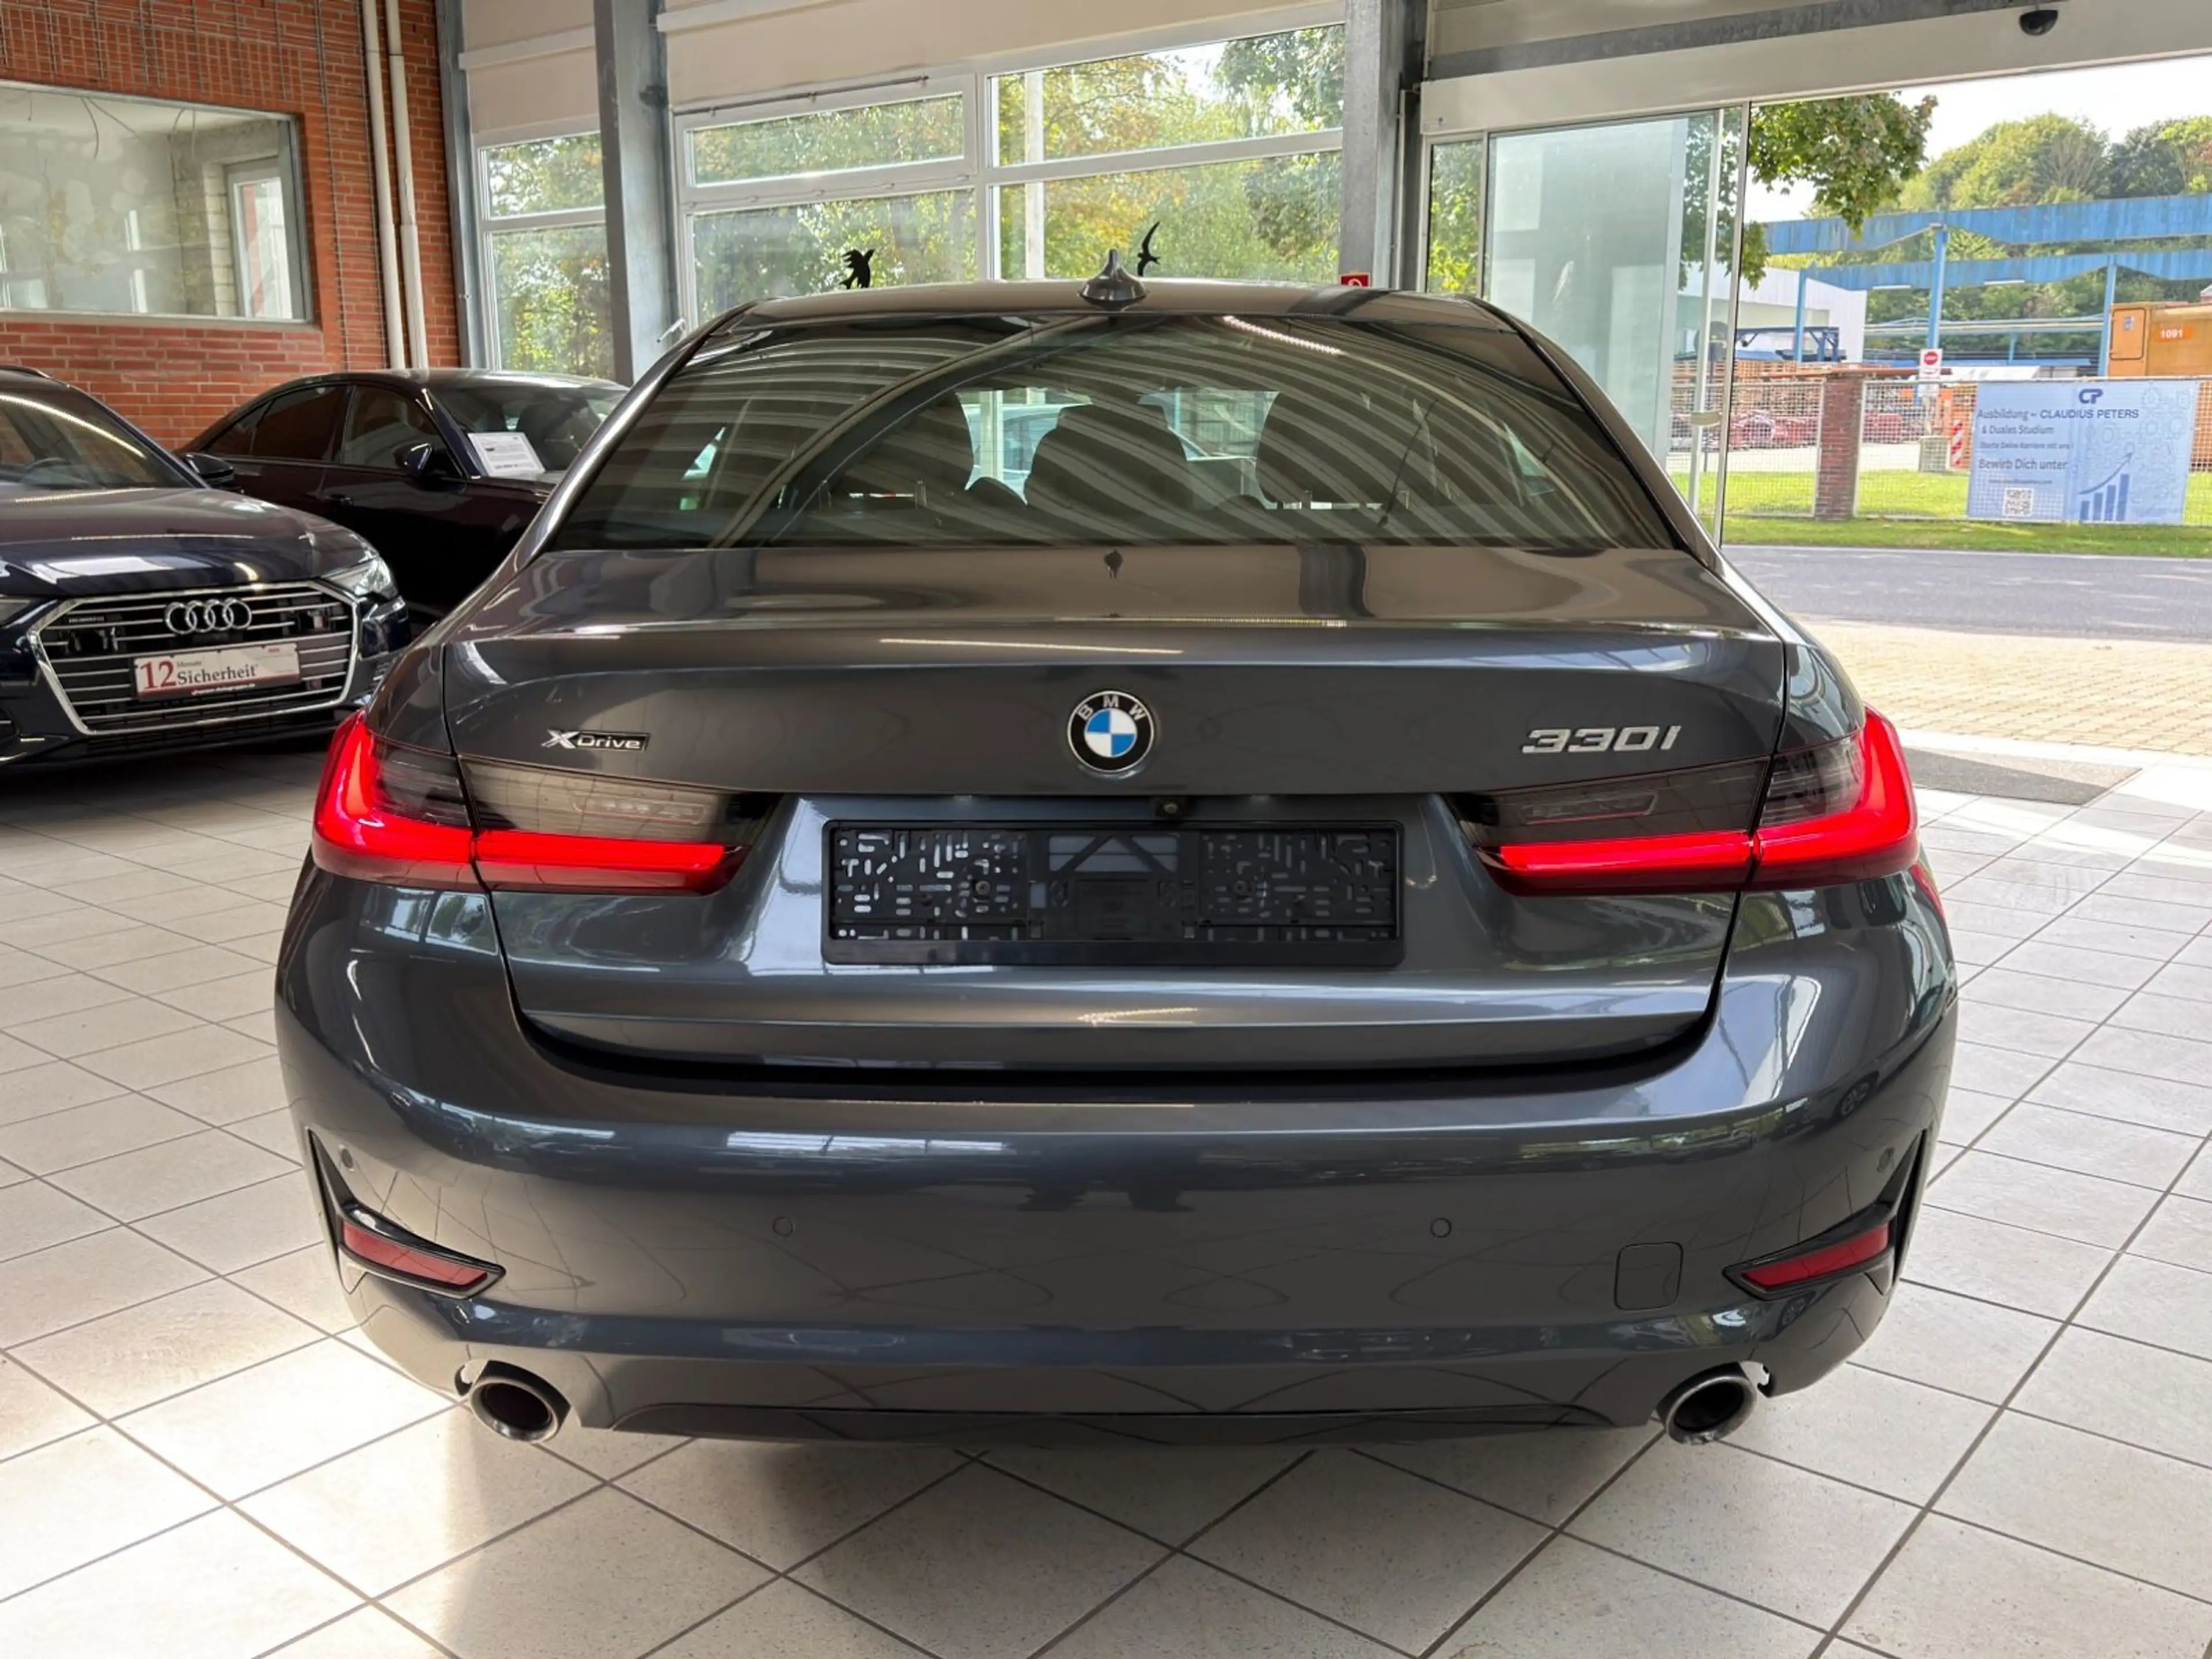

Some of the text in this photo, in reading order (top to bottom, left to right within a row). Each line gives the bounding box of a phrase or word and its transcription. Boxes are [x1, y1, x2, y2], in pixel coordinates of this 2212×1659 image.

[1977, 409, 2029, 421] Ausbildung
[2040, 409, 2094, 419] CLAUDIUS
[2097, 409, 2139, 419] PETERS
[1989, 425, 2017, 434] Duales
[2018, 425, 2055, 434] Studium
[1978, 459, 2068, 470] Bewirb Dich unter
[140, 661, 176, 689] 12
[177, 664, 256, 685] Sicherheit
